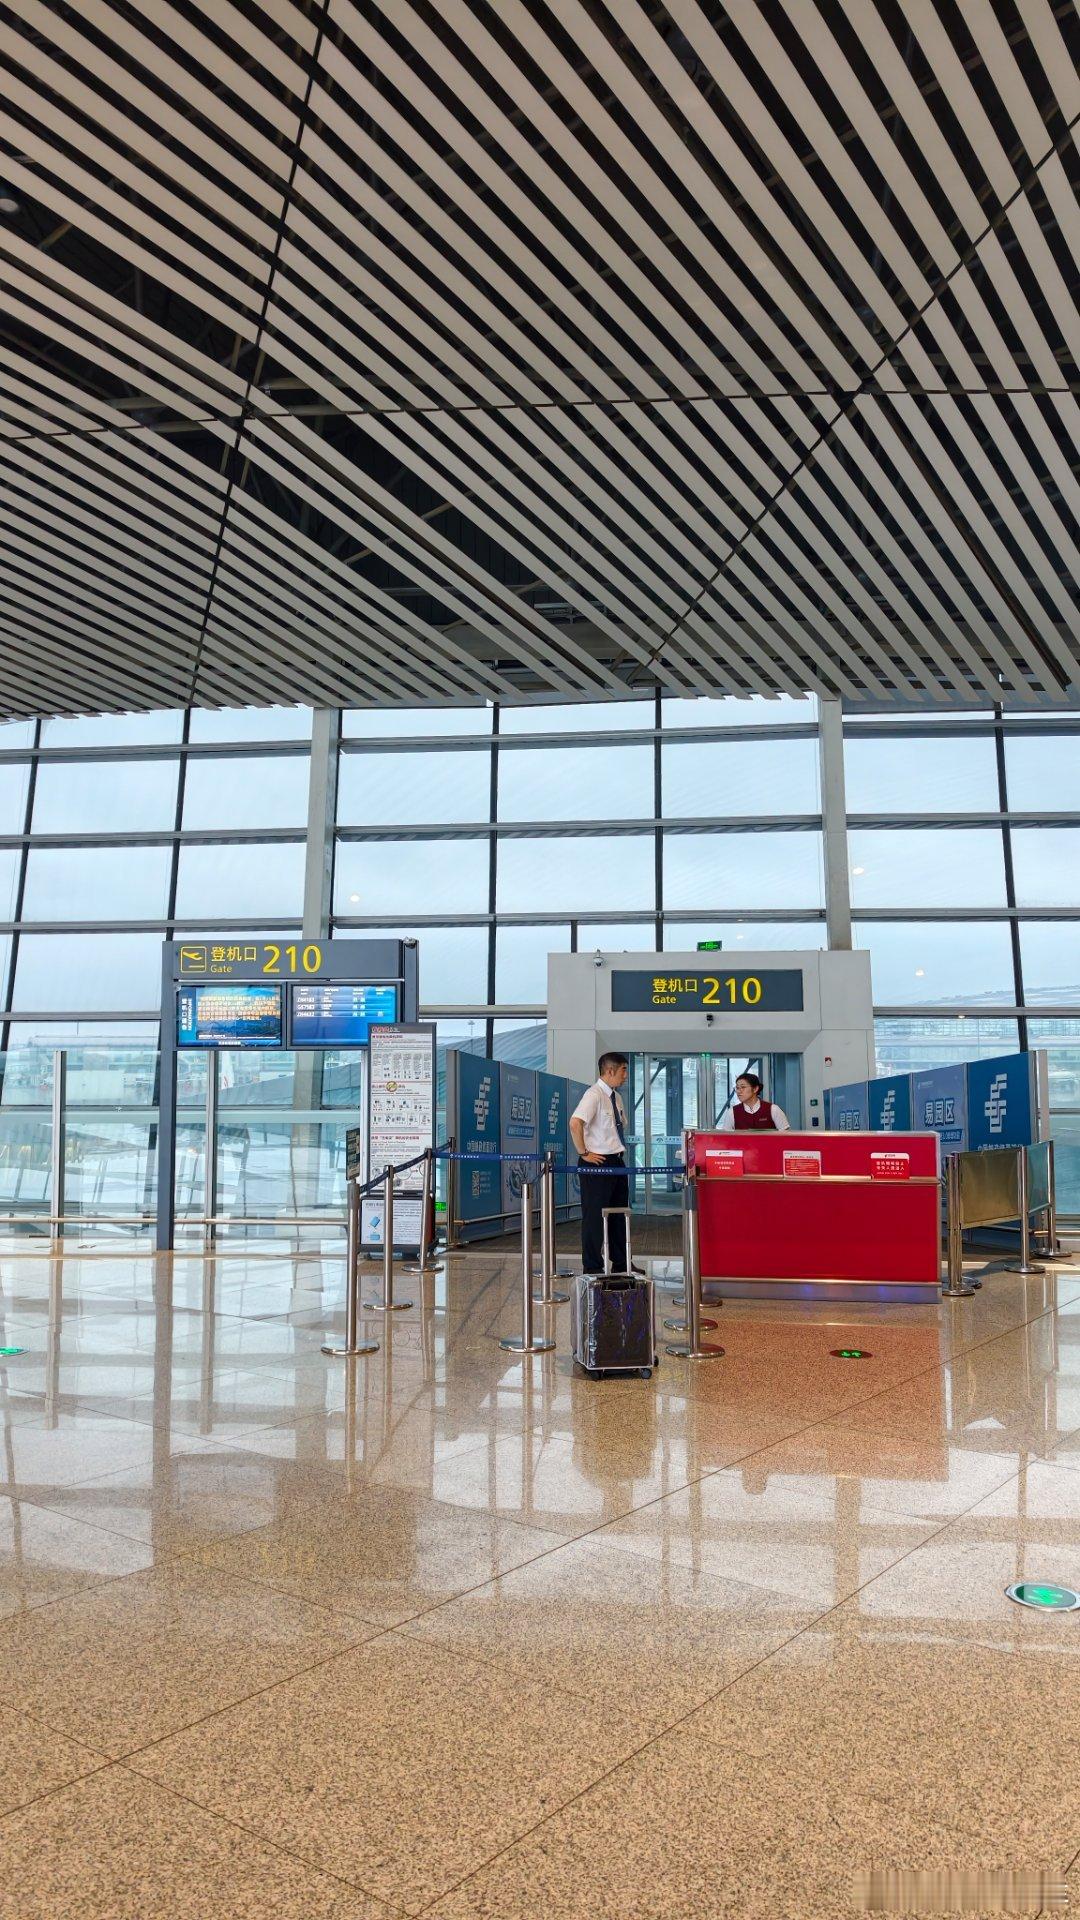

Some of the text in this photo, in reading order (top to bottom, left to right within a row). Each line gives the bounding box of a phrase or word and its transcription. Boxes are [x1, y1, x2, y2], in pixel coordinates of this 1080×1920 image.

[210, 945, 322, 973] 登机口 210
[210, 964, 233, 973] Gate
[652, 977, 763, 1004] 登机口 210
[652, 995, 677, 1004] Gate
